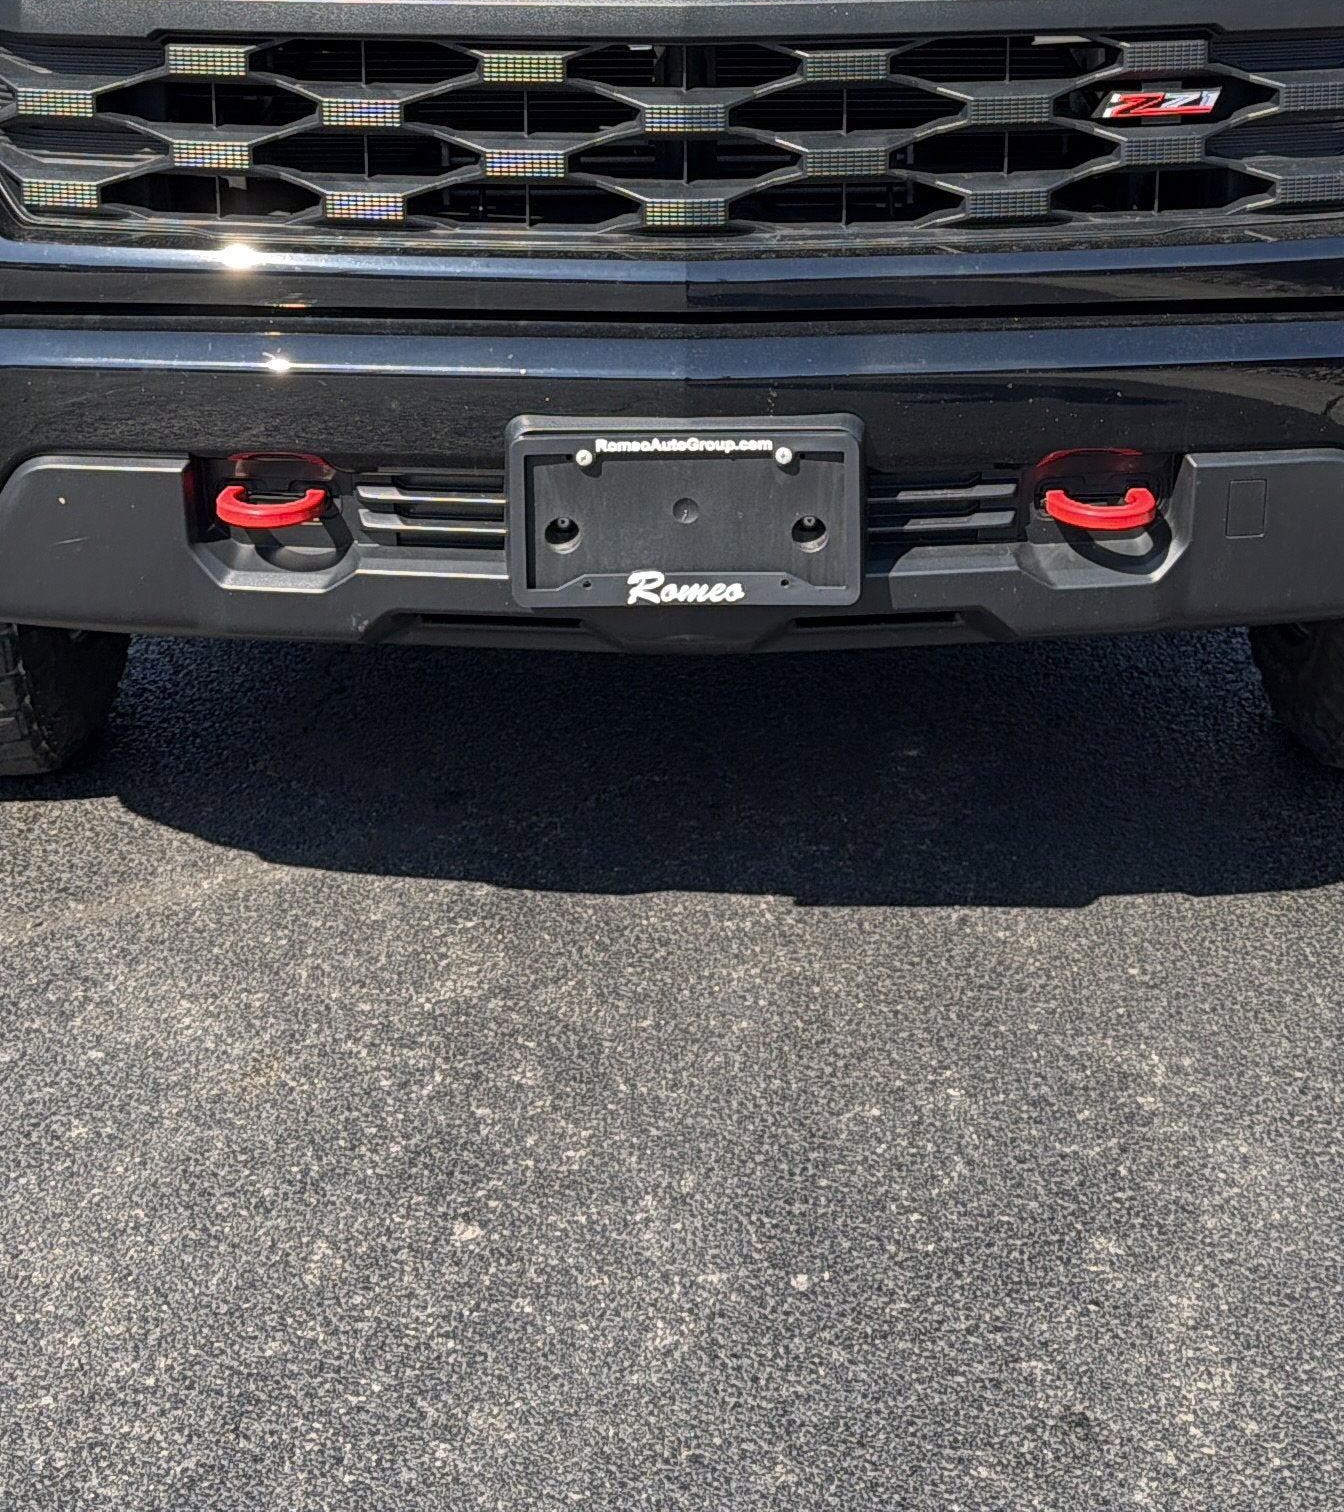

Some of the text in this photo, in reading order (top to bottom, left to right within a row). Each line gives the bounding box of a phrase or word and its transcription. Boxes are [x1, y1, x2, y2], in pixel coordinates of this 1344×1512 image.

[1102, 90, 1222, 118] Z71
[594, 437, 774, 454] RomeoAutoGroup.com
[626, 570, 746, 605] Romeo
